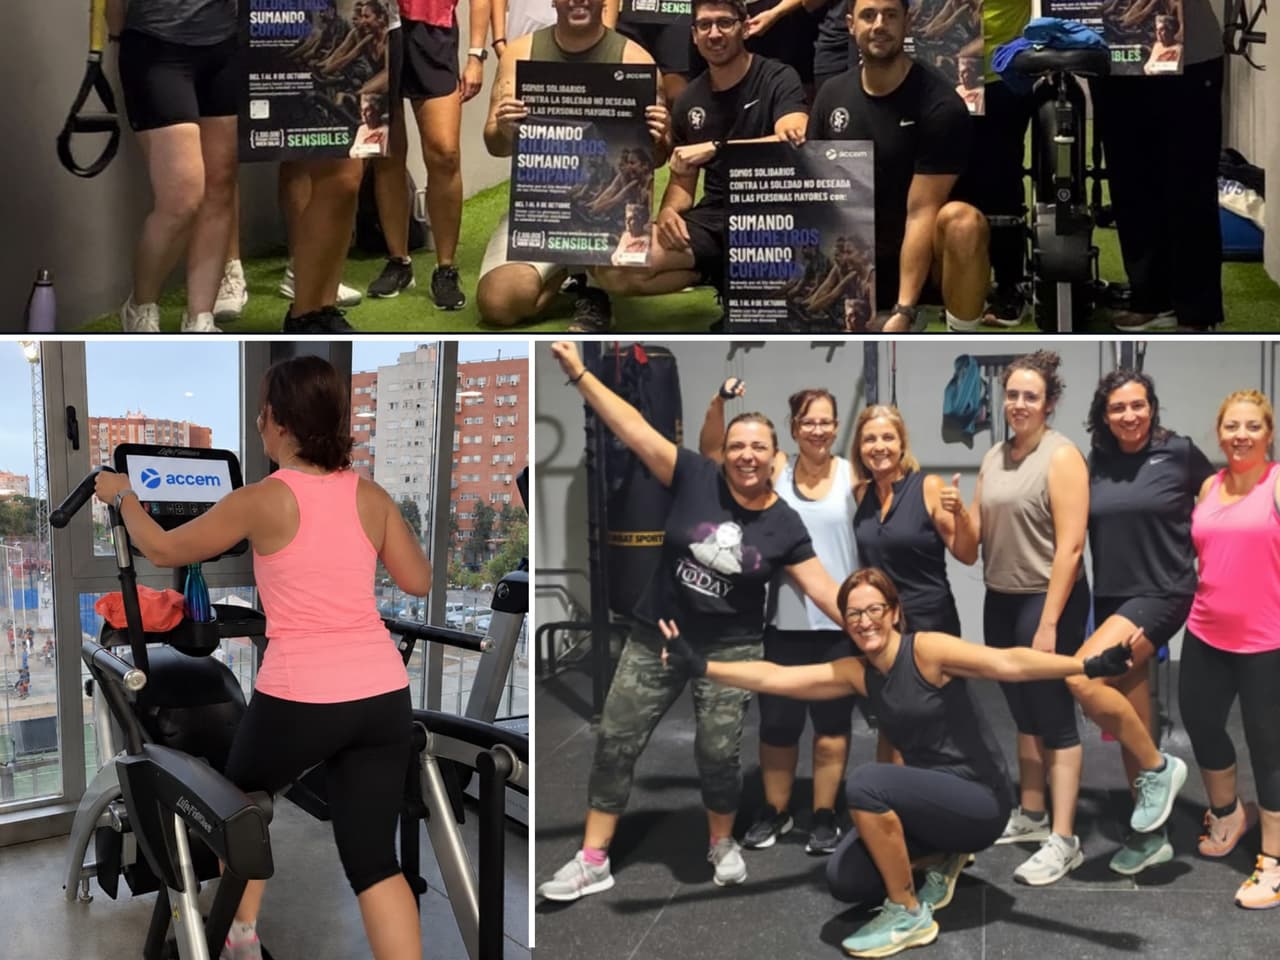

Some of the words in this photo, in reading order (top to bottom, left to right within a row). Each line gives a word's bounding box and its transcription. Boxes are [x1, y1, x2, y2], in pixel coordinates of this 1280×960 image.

[250, 11, 305, 23] SUMANDO
[287, 132, 350, 147] SENSIBLES
[519, 125, 583, 140] SUMANDO
[518, 154, 579, 170] SUMANDO
[729, 215, 794, 231] SUMANDO
[548, 237, 608, 251] SENSIBLES
[729, 247, 792, 263] SUMANDO
[166, 473, 221, 487] accem
